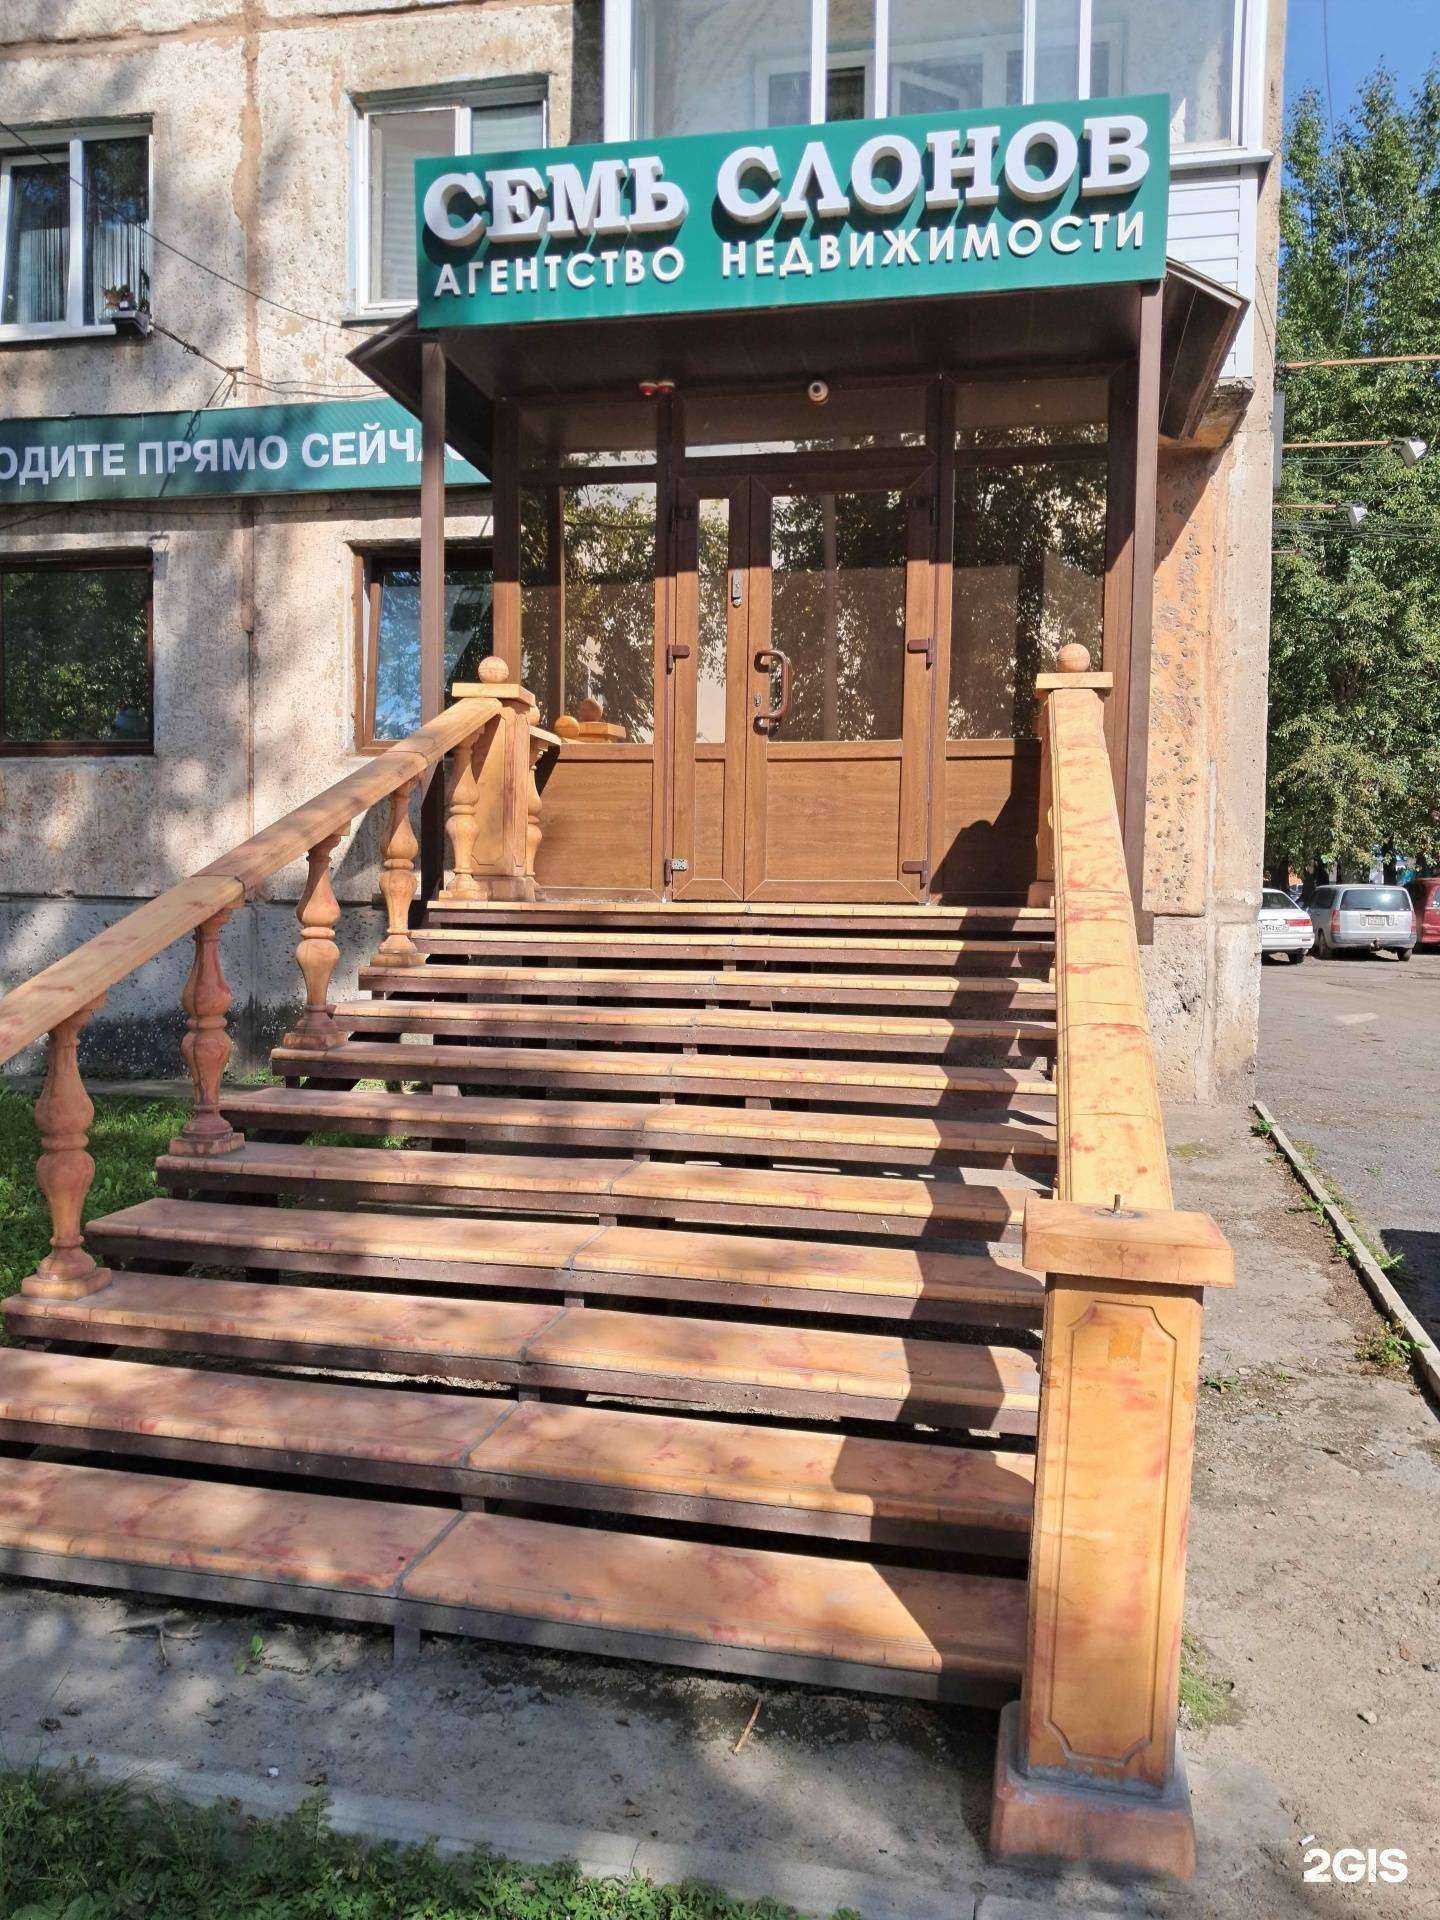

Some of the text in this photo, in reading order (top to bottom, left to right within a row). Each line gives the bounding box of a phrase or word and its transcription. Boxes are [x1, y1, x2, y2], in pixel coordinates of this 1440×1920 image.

[423, 115, 1150, 246] СЕМЬ СЛОНОВ
[433, 211, 1145, 298] АГЕНТСТВО НЕДВИЖИМОСТИ
[138, 435, 289, 475] ПРЯМО
[301, 422, 465, 468] СЕЙЧ
